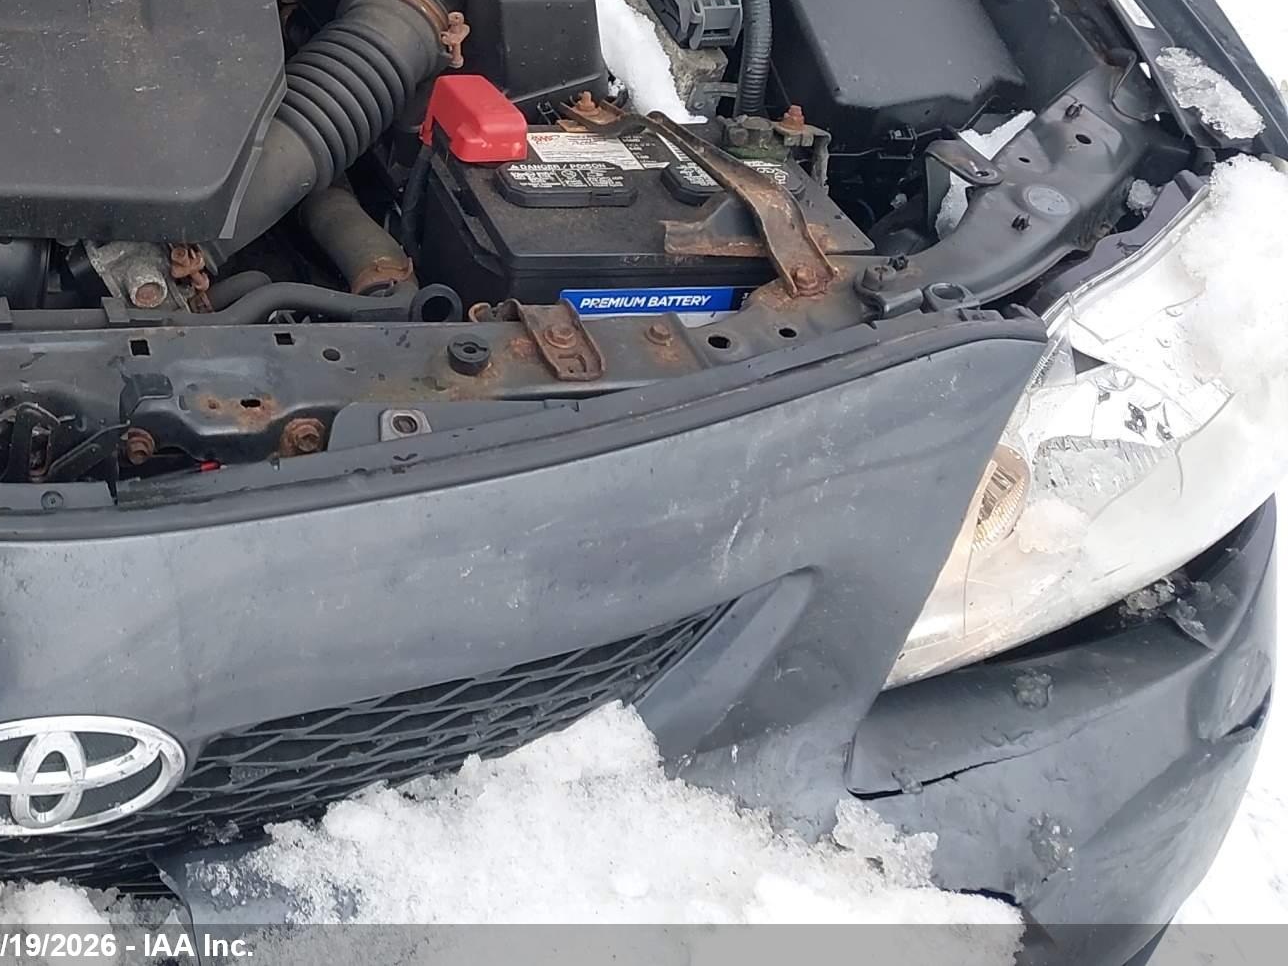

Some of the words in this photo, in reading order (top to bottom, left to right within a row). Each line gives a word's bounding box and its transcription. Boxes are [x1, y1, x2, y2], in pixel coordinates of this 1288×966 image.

[520, 163, 561, 171] DANGER
[580, 296, 646, 308] PREMIUM
[647, 295, 711, 308] BATTERY
